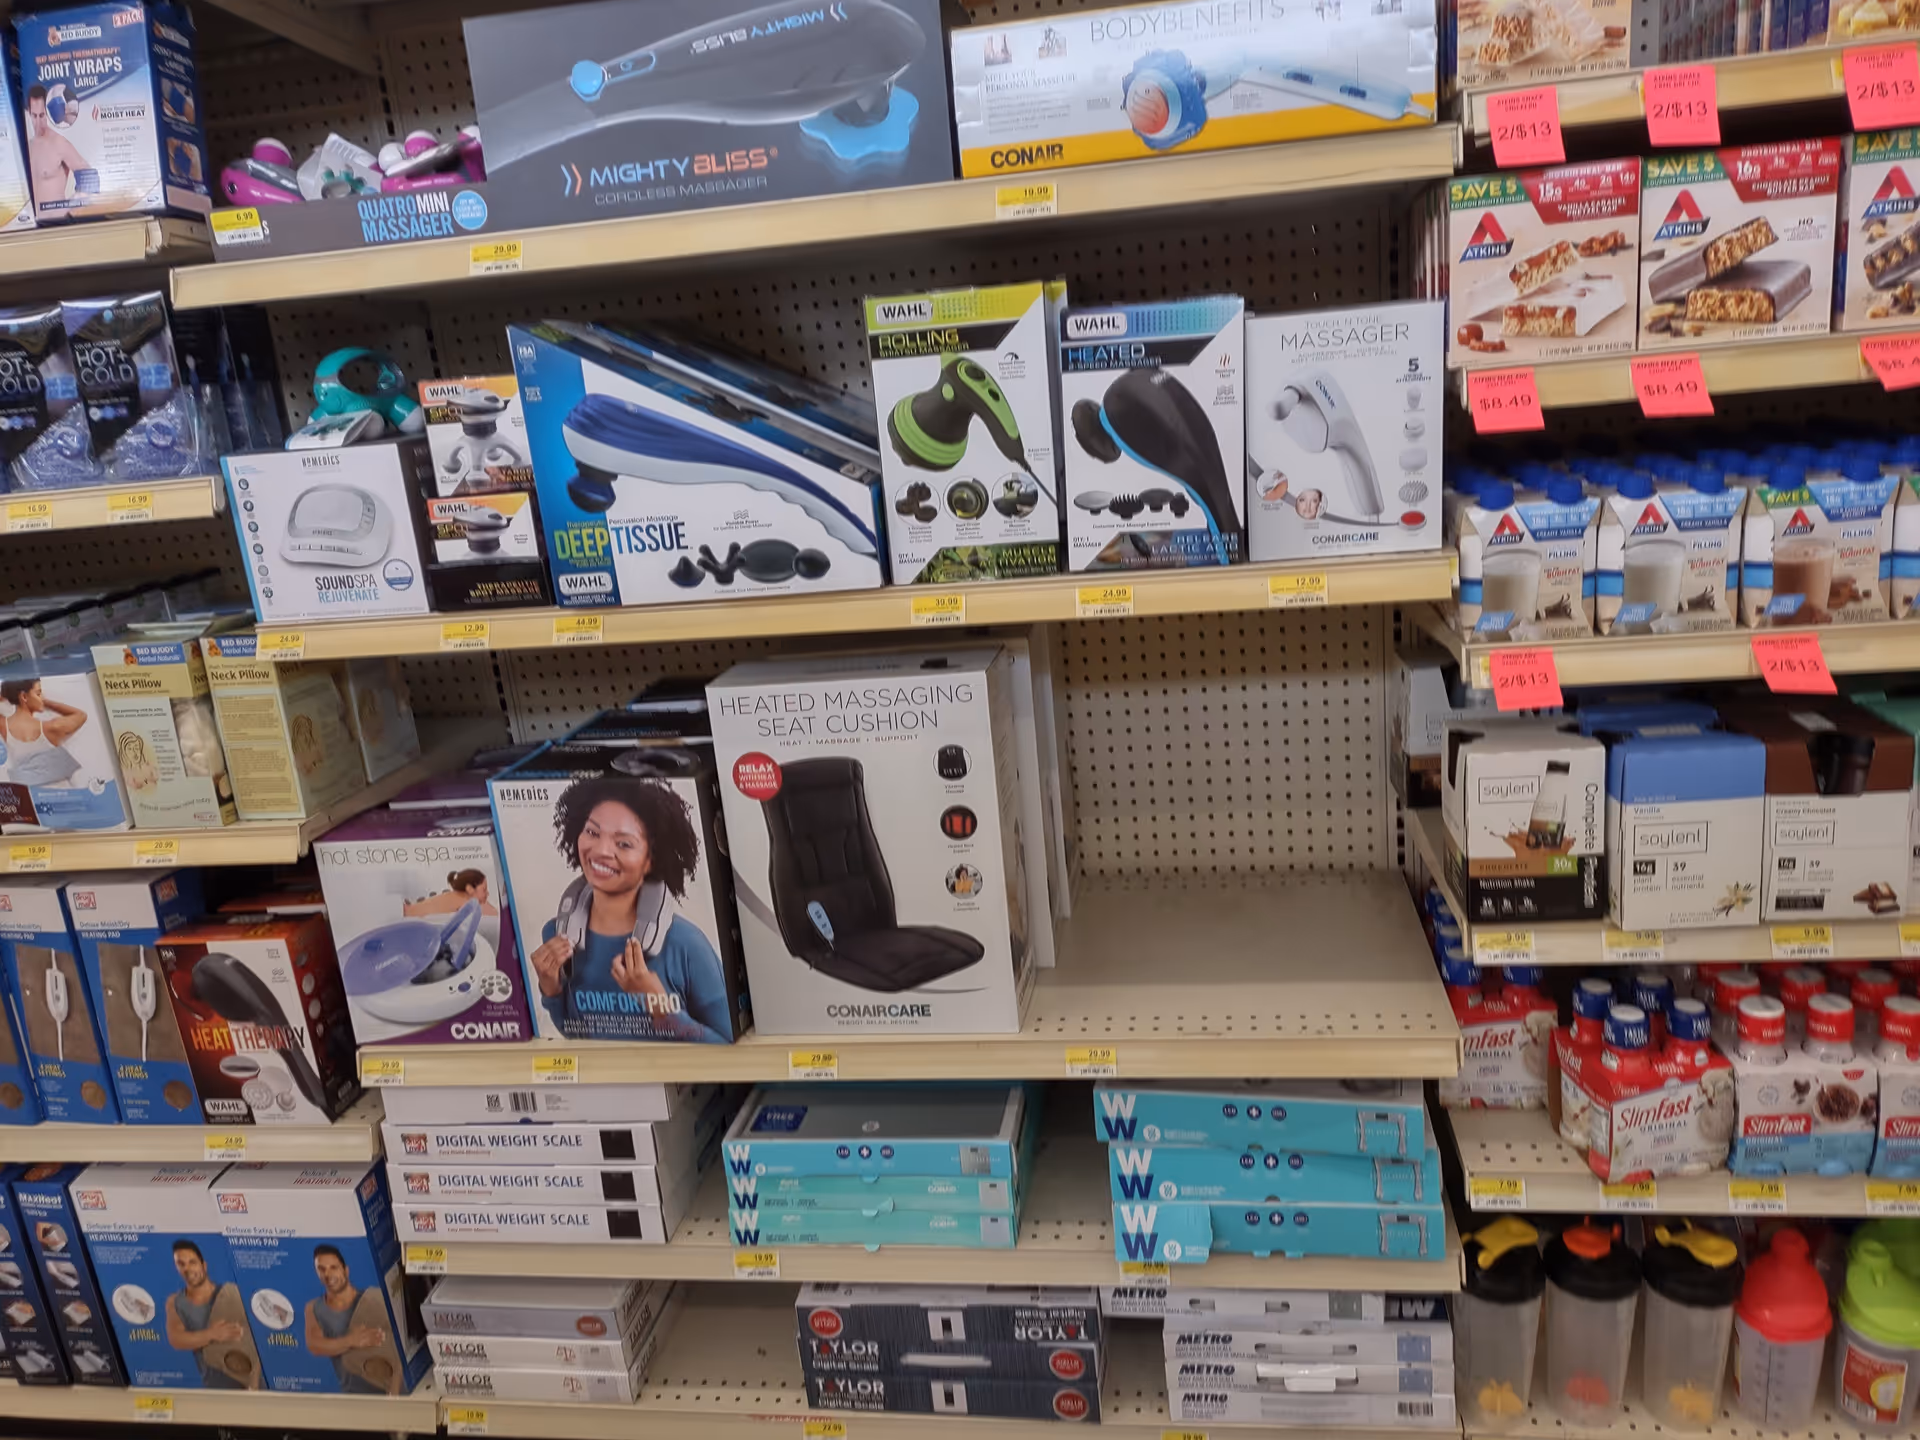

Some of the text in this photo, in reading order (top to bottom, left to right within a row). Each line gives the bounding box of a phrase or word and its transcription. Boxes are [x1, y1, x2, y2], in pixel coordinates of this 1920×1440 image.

[38, 56, 122, 82] JOINT WRAPS
[74, 75, 98, 88] LARGE
[1856, 80, 1915, 101] 2/$13
[101, 109, 145, 119] MOIST HEAT
[1653, 100, 1708, 119] 2/$13
[1497, 122, 1552, 142] 2/$13
[990, 143, 1064, 169] CONAIR
[589, 157, 690, 186] MIGHTY
[1647, 154, 1700, 178] SAVE
[595, 176, 768, 207] CORDLESS MASSAGER
[1451, 180, 1502, 202] SAVE
[236, 211, 254, 222] 6.99
[361, 212, 454, 242] MASSAGER
[1659, 222, 1703, 238] ATKINS
[1465, 243, 1508, 258] ATKINS
[883, 304, 926, 319] WAHL
[1075, 317, 1120, 332] WAHL
[879, 328, 960, 350] ROLLING
[1281, 323, 1410, 352] MASSAGER
[1068, 343, 1146, 363] HEATED
[1408, 357, 1420, 373] 5
[81, 366, 133, 386] COLD
[430, 386, 460, 398] WAHL
[128, 496, 148, 505] 16.99
[1767, 492, 1798, 504] SAVE
[28, 504, 47, 513] 16.99
[437, 503, 467, 514] WAHL
[609, 514, 678, 526] Percussion Massage
[1635, 524, 1669, 535] ATKINS
[1842, 529, 1873, 539] FILLING
[554, 522, 689, 560] DEEP TISSUE
[1312, 532, 1379, 546] CONAIRCARE
[1491, 533, 1522, 545] ATKINS
[1152, 543, 1201, 554] LACTIC
[1692, 541, 1722, 550] FILLING
[1548, 550, 1578, 560] FILLING
[565, 573, 607, 590] WAHL
[318, 588, 379, 604] REJUVENATE
[1103, 588, 1127, 598] 24.99
[463, 624, 485, 633] 12.99
[576, 618, 597, 627] 44.99
[221, 638, 235, 647] BED
[279, 635, 300, 644] 24.99
[136, 645, 175, 655] BED BUDDY
[139, 654, 159, 664] Herbal
[211, 669, 270, 681] Neck Pillow
[105, 678, 162, 690] Neck Pillow
[720, 684, 974, 716] HEATED MASSAGING
[757, 709, 939, 738] SEAT CUSHION
[779, 734, 919, 748] HEAT MASSAGE SUPPORT
[738, 763, 774, 774] RELAX
[745, 781, 778, 790] MASSAGE
[1484, 780, 1534, 799] soylent
[1583, 782, 1599, 851] Complete
[1633, 806, 1661, 815] Vanilla
[426, 826, 493, 838] CONAIR
[1779, 826, 1829, 841] soylent
[1639, 829, 1701, 849] soylent
[28, 846, 46, 855] 19.99
[320, 846, 452, 866] hot stone spa
[1672, 861, 1687, 873] 39
[1633, 876, 1653, 886] plant
[1633, 885, 1661, 894] protein
[82, 931, 107, 939] HEATING
[826, 1003, 932, 1019] CONAIRCARE
[191, 1022, 307, 1051] HEAT THERAPY
[451, 1021, 521, 1041] CONAIR
[811, 1053, 832, 1063] 29.99
[1088, 1048, 1111, 1059] 29.99
[552, 1058, 573, 1067] 34.99
[210, 1100, 242, 1112] WAHL
[1100, 1094, 1137, 1118] W
[1748, 1116, 1807, 1135] Slimfast
[225, 1136, 243, 1145] 24.99
[436, 1135, 486, 1147] DIGITAL
[490, 1135, 538, 1148] WEIGHT
[542, 1135, 583, 1148] SCALE
[1745, 1137, 1784, 1145] ORIGINAL
[150, 1175, 188, 1183] HEATING
[292, 1177, 353, 1186] HEATING PAD
[438, 1174, 584, 1188] DIGITAL WEIGHT SCALE
[1500, 1179, 1518, 1189] 7.99
[1760, 1183, 1779, 1193] 7.99
[18, 1191, 62, 1205] MaxHeat
[79, 1191, 100, 1202] drug
[220, 1194, 241, 1206] drug
[444, 1213, 590, 1226] DIGITAL WEIGHT SCALE
[113, 1222, 134, 1230] Extra
[135, 1223, 156, 1232] Large
[253, 1226, 274, 1235] Extra
[275, 1227, 297, 1237] Large
[88, 1233, 139, 1243] HEATING PAD
[228, 1237, 279, 1247] HEATING PAD
[754, 1253, 774, 1264] 19.99
[1112, 1287, 1168, 1299] METRO
[629, 1304, 651, 1351] TAYLOR
[1014, 1325, 1089, 1341] TAYLOR
[1177, 1333, 1233, 1345] METRO
[438, 1342, 486, 1354] TAYLOR
[810, 1338, 880, 1357] TAYLOR
[812, 1360, 880, 1372] Digital Scale
[1179, 1363, 1236, 1376] METRO
[815, 1377, 885, 1398] TAYLOR
[818, 1397, 853, 1409] Digital
[1182, 1392, 1229, 1403] METRO
